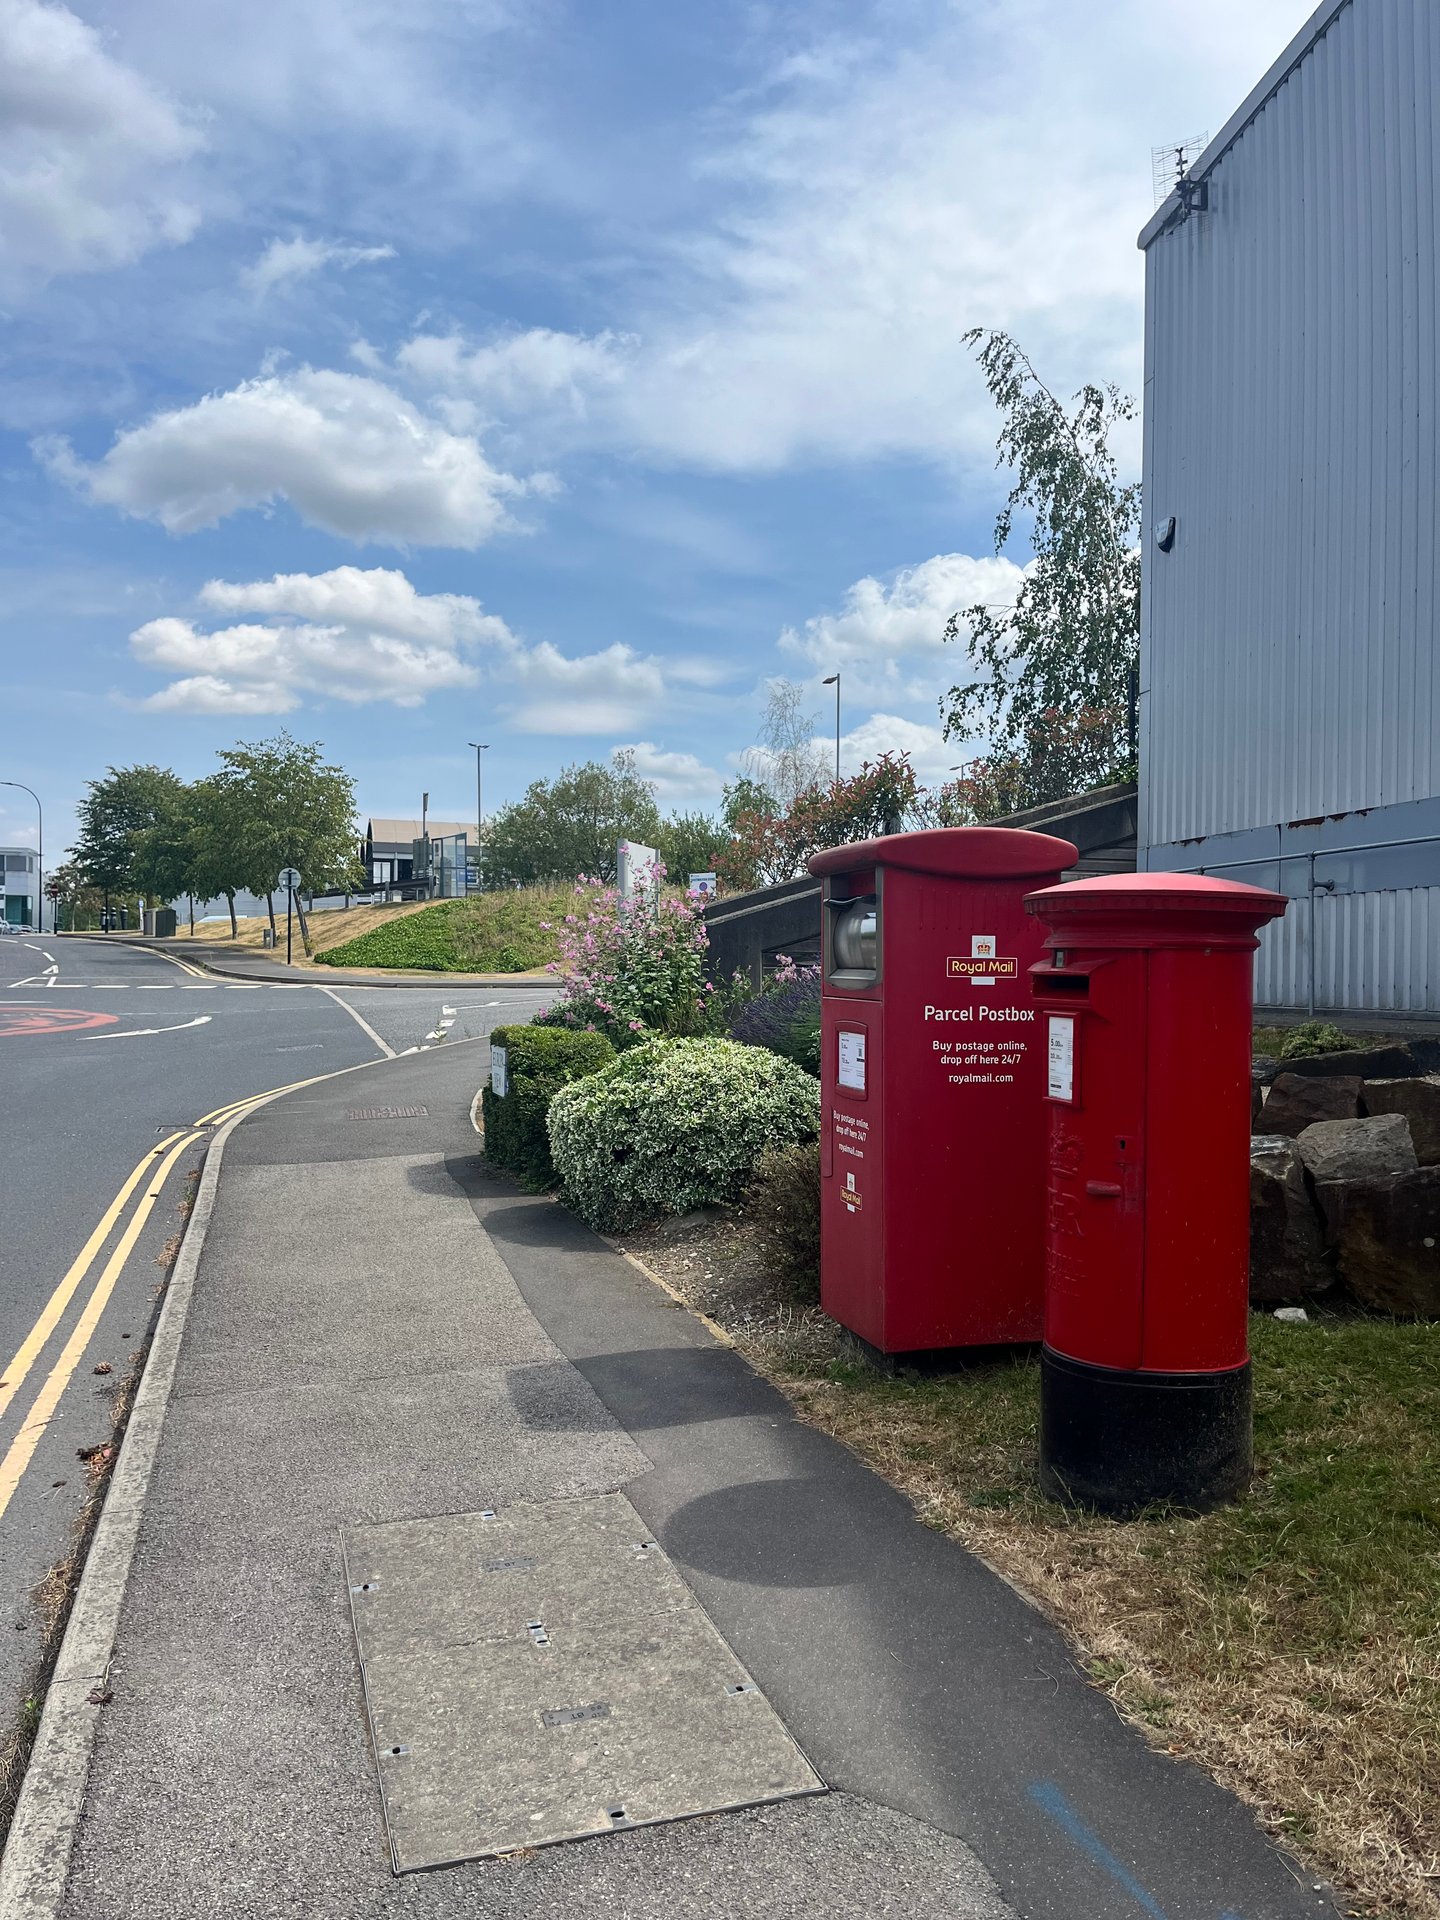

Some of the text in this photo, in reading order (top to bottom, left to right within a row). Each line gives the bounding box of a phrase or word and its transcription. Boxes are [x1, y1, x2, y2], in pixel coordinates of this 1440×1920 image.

[952, 961, 1013, 974] Royal Mail
[924, 1005, 1035, 1021] Parcel Postbox
[932, 1040, 1028, 1052] Buy postage online,
[940, 1054, 1021, 1066] drop off here 24/7
[948, 1073, 1014, 1084] royalmail.com
[833, 1110, 841, 1121] Buy
[841, 1114, 856, 1126] postage
[836, 1124, 844, 1135] drop
[849, 1128, 858, 1139] here
[841, 1189, 861, 1205] Royal Mail
